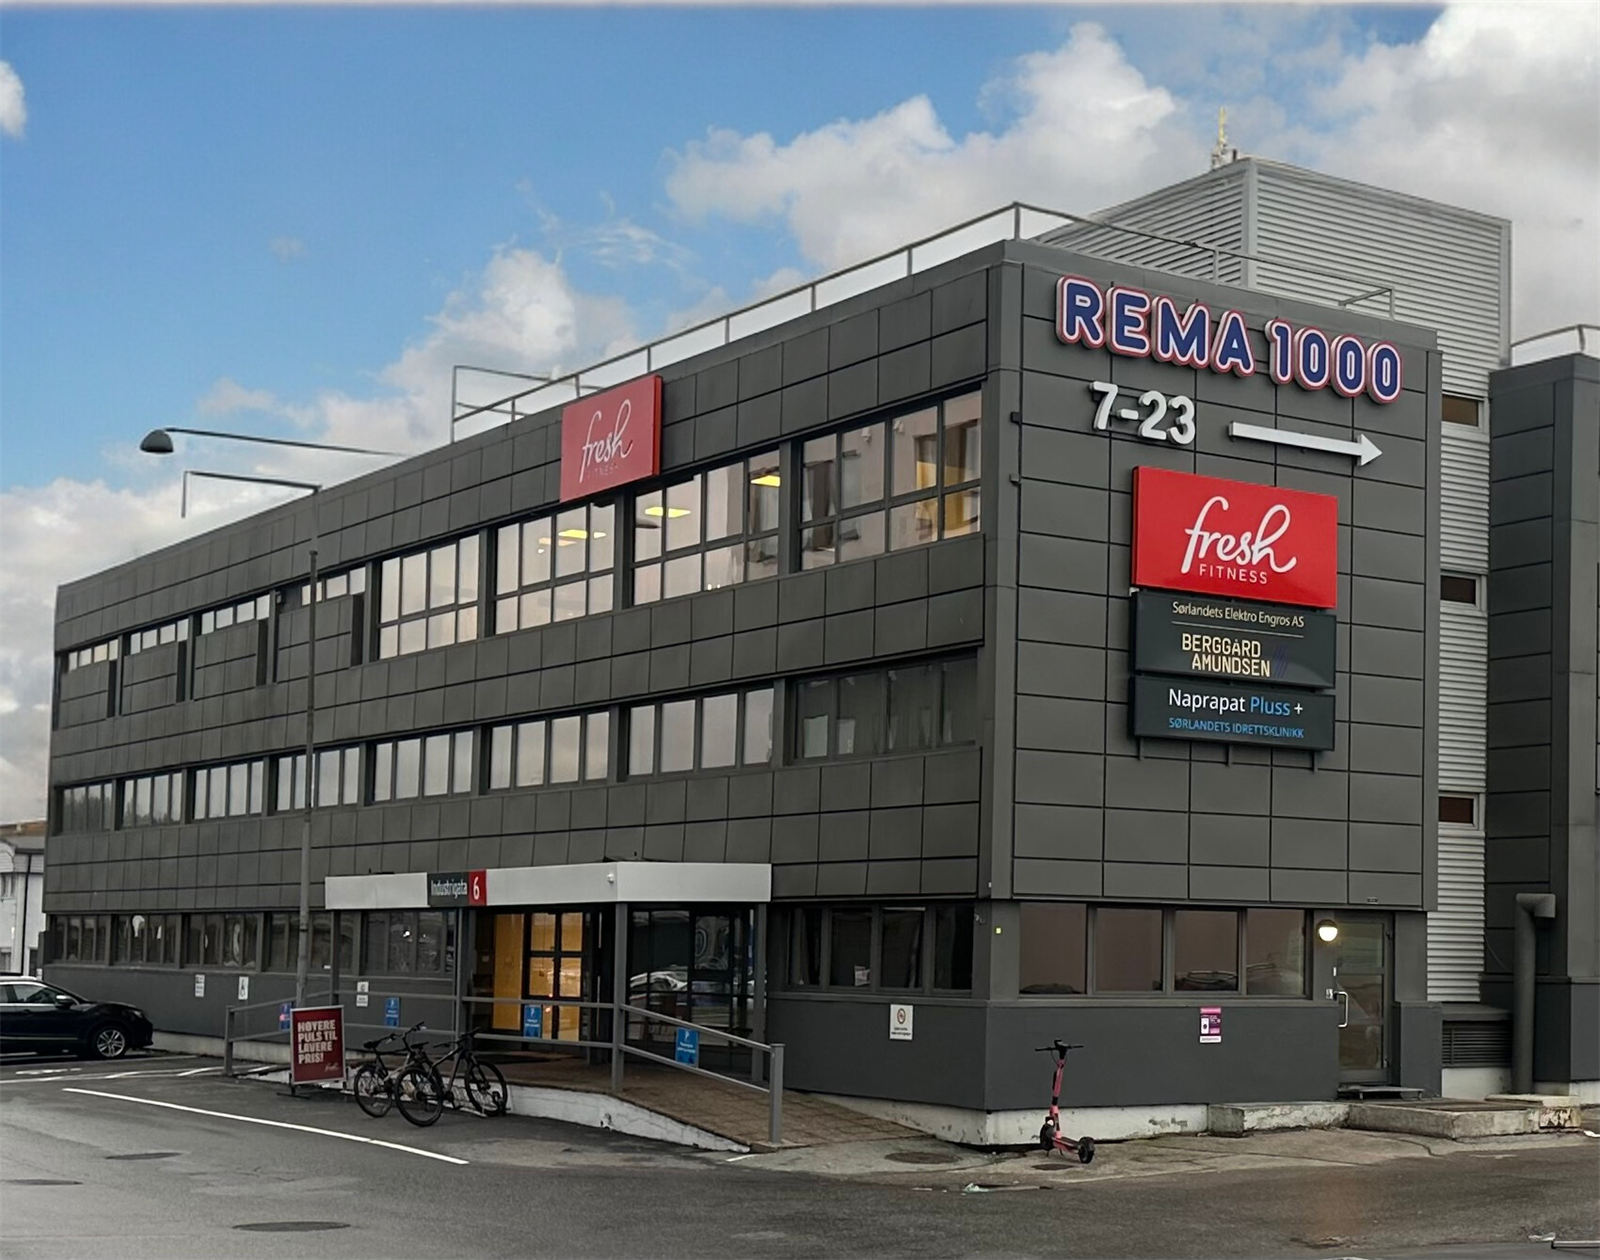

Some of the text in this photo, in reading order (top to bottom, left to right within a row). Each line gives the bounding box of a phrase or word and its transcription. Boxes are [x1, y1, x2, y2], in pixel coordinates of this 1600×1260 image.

[1056, 275, 1402, 404] REMA 1000
[1089, 380, 1196, 445] 7-23
[579, 399, 634, 483] fresh
[1180, 496, 1297, 574] fresh
[1199, 564, 1268, 584] FITNESS
[1172, 602, 1305, 628] Sørlandets Elektro Engros AS
[1182, 633, 1261, 658] BERGGÅRD
[1191, 653, 1271, 677] AMUNDSEN
[1169, 688, 1246, 715] Naprapat
[1250, 696, 1291, 716] Pluss
[1169, 717, 1305, 738] SØRLANDETS IDRETTSKLINIKK
[473, 876, 480, 900] 6
[298, 1030, 338, 1043] PULS TIL
[298, 1041, 333, 1053] LAVERE
[298, 1053, 324, 1064] PRIS!
